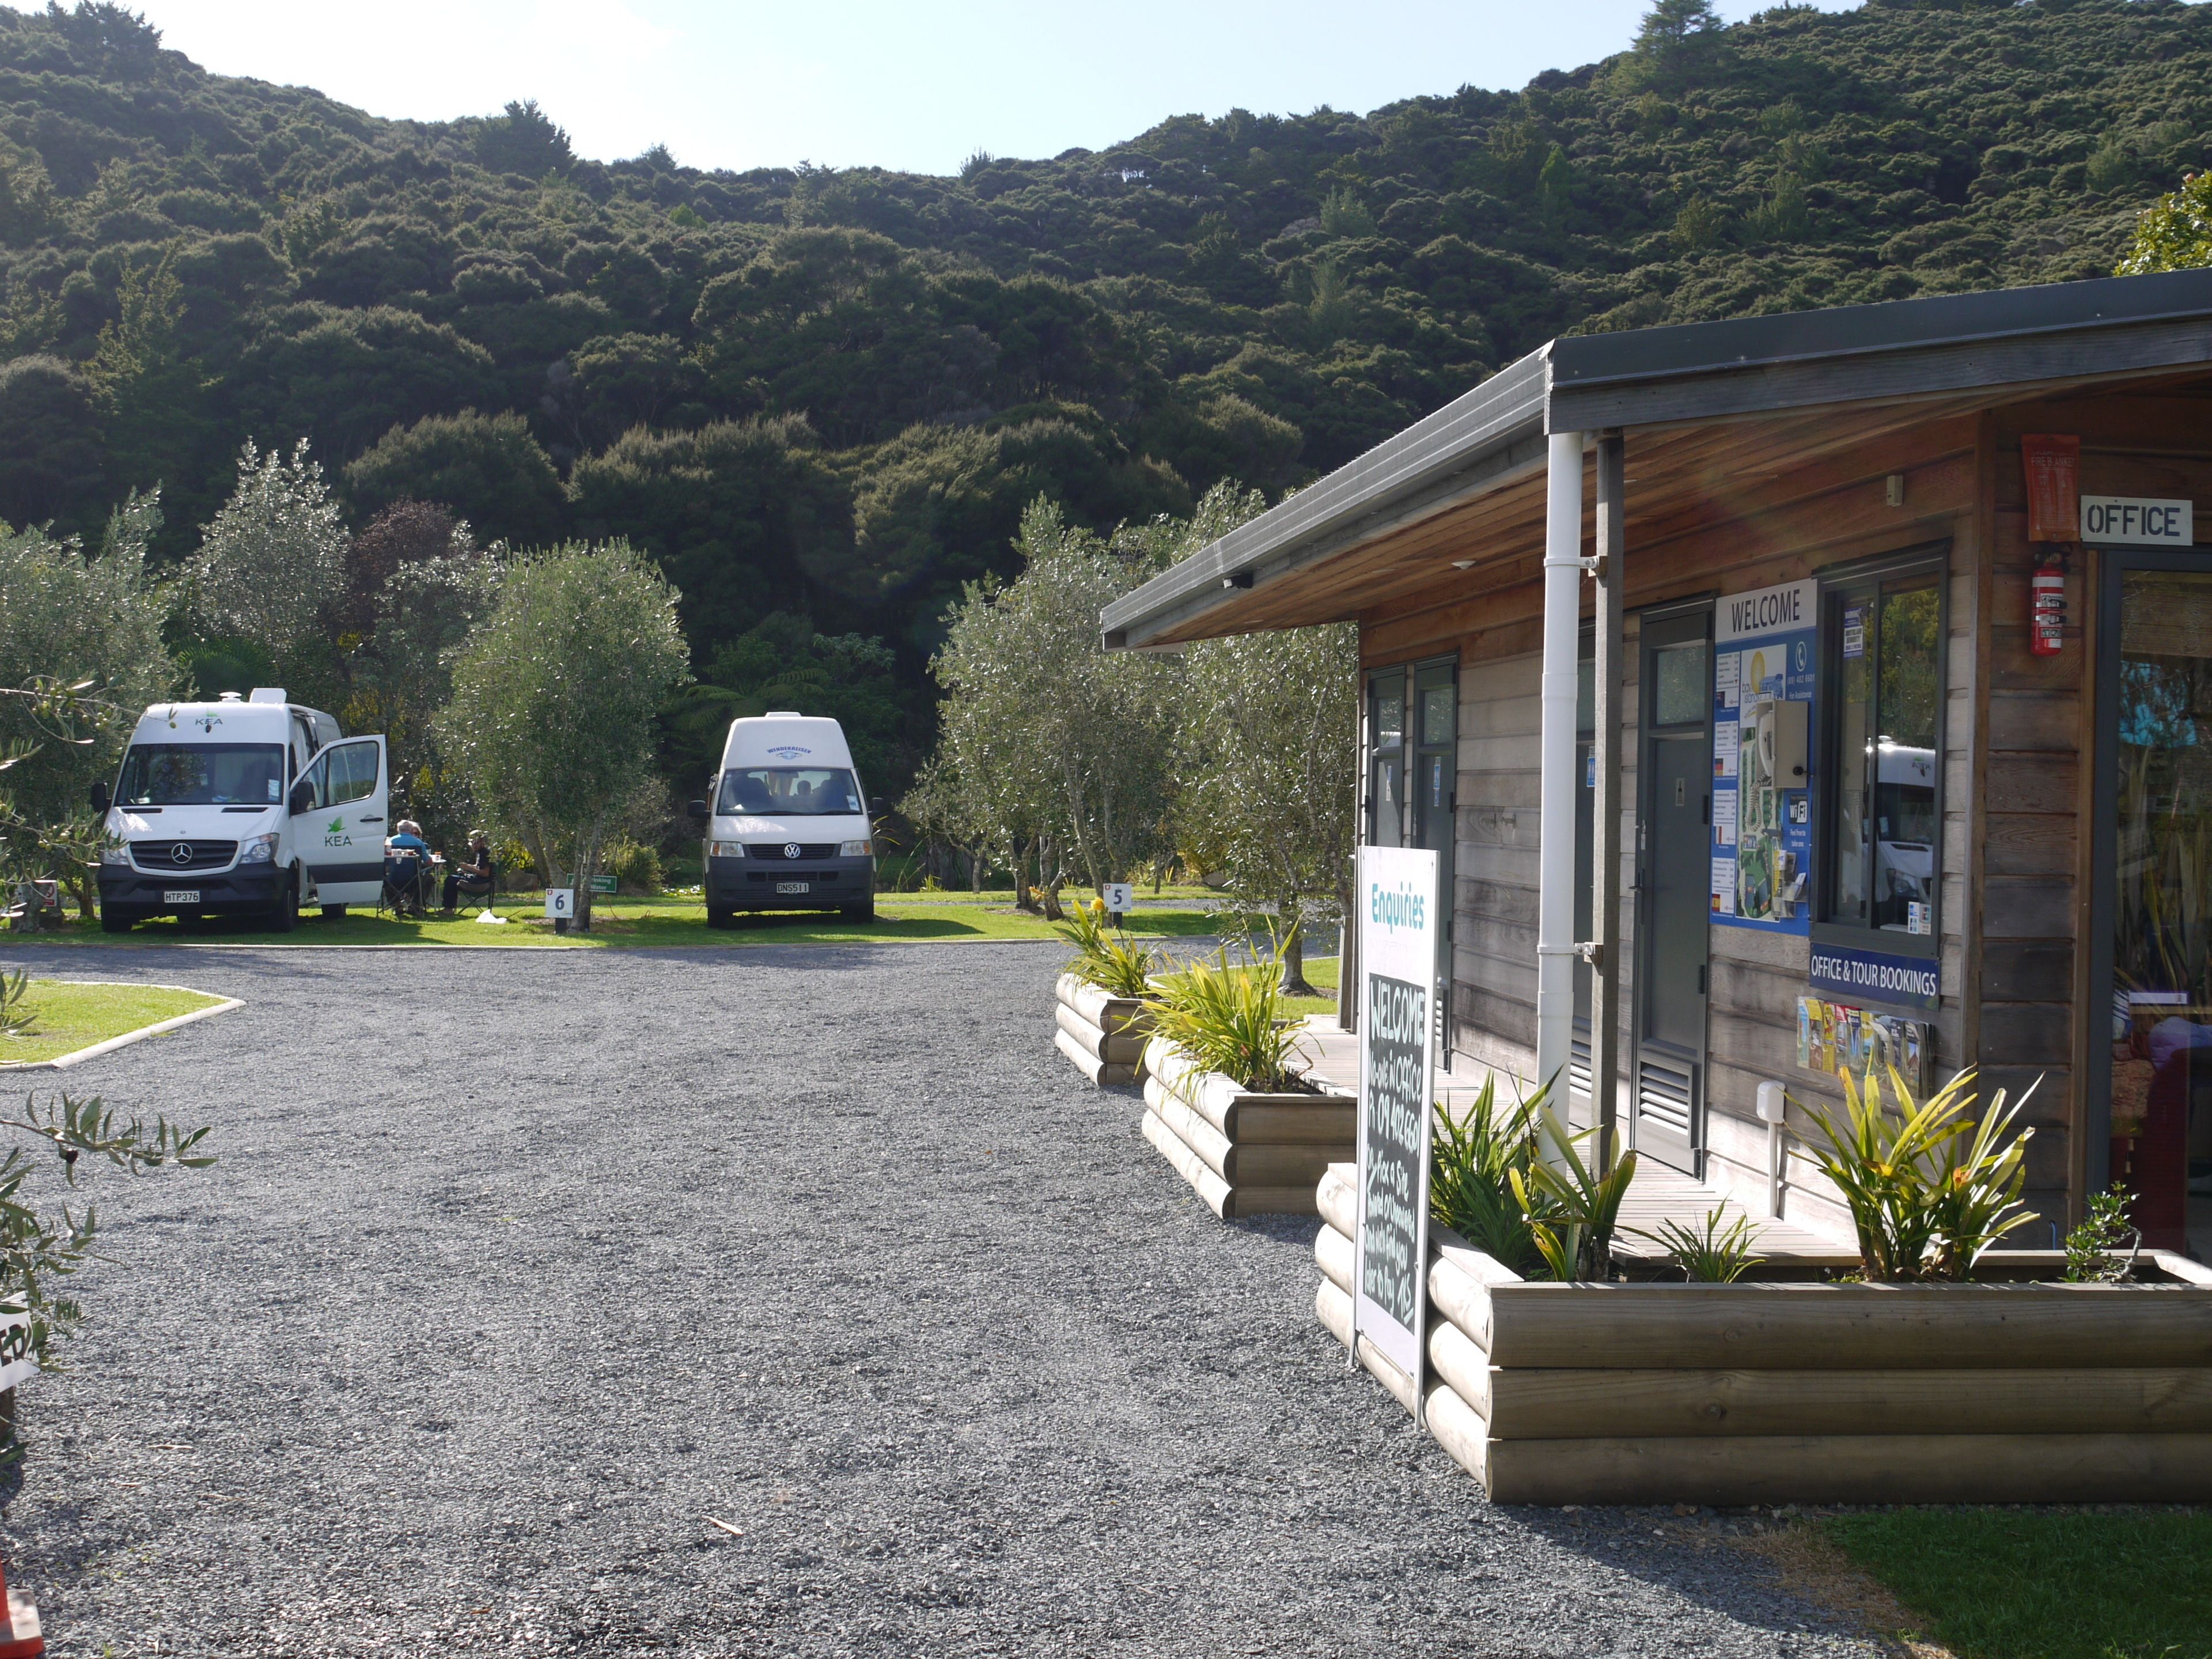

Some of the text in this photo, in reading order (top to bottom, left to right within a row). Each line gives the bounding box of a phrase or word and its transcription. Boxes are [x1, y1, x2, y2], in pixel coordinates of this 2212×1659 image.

[2087, 504, 2180, 537] OFFICE
[1732, 589, 1800, 632] WELCOME
[324, 835, 353, 847] KEA
[165, 891, 199, 903] HTP376
[555, 894, 565, 910] 6
[778, 883, 809, 893] DNS511
[1113, 889, 1122, 905] 5
[1372, 881, 1425, 934] Enquiries
[1811, 955, 1936, 996] OFFICE & TOUR BOOKINGS
[1370, 979, 1426, 1047] WELCOME
[1377, 1092, 1390, 1141] 09
[1391, 1096, 1404, 1146] 402
[1404, 1109, 1421, 1160] 6601
